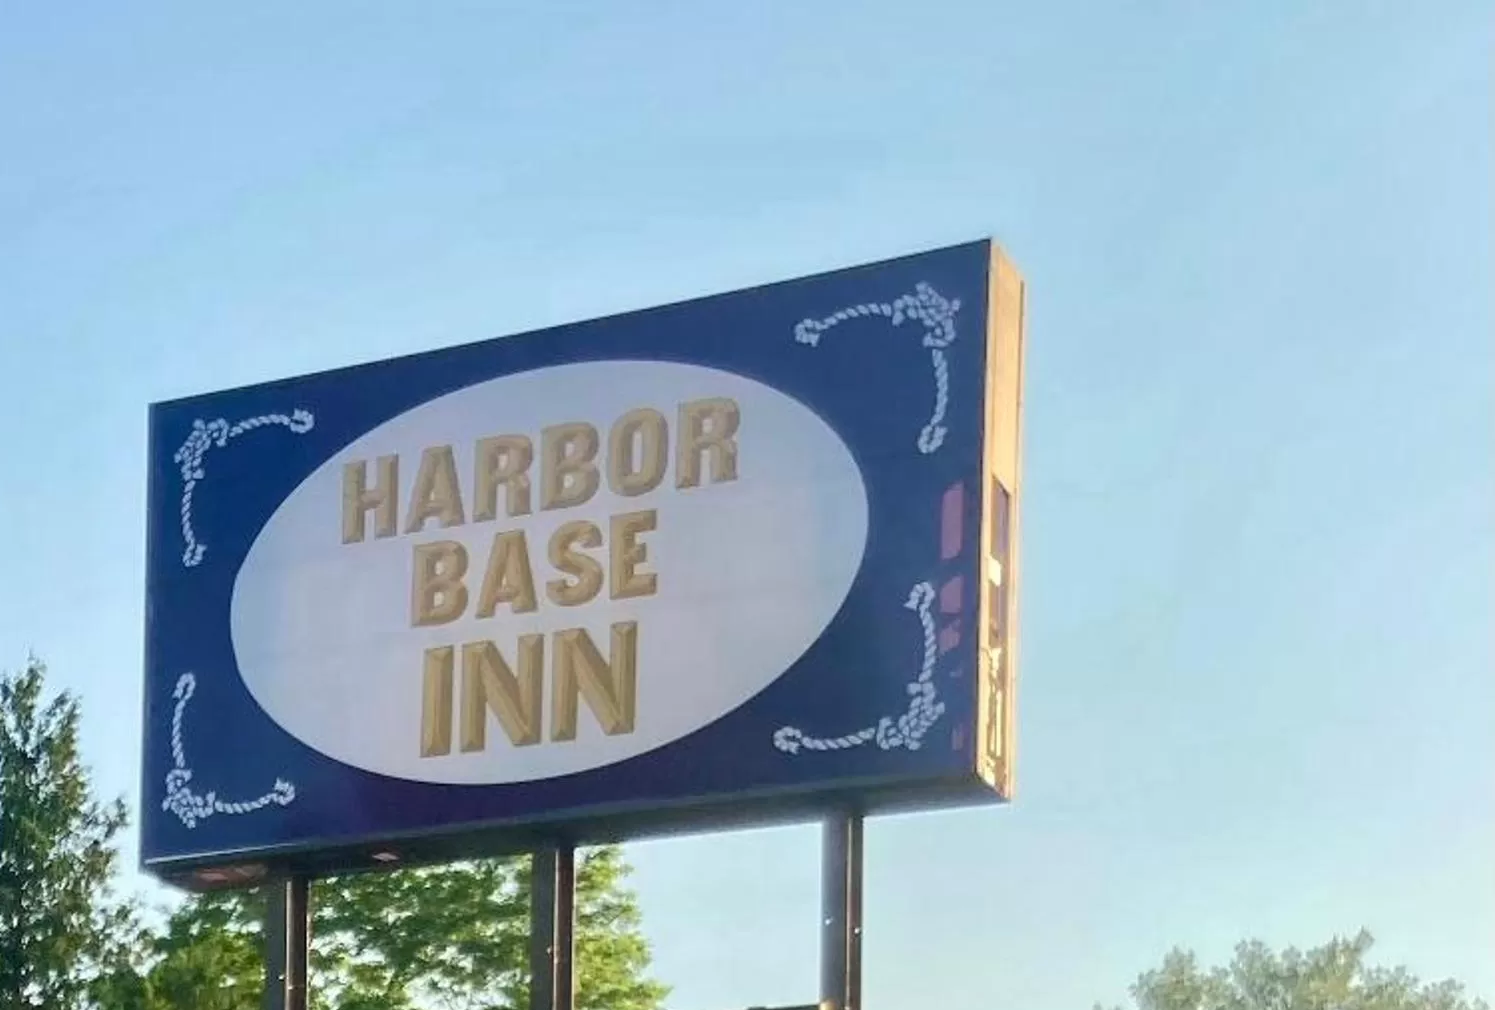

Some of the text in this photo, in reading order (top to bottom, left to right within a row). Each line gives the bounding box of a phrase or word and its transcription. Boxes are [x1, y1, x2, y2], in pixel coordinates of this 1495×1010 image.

[342, 397, 740, 544] HARBOR
[412, 510, 658, 627] BASE
[422, 622, 638, 757] INN
